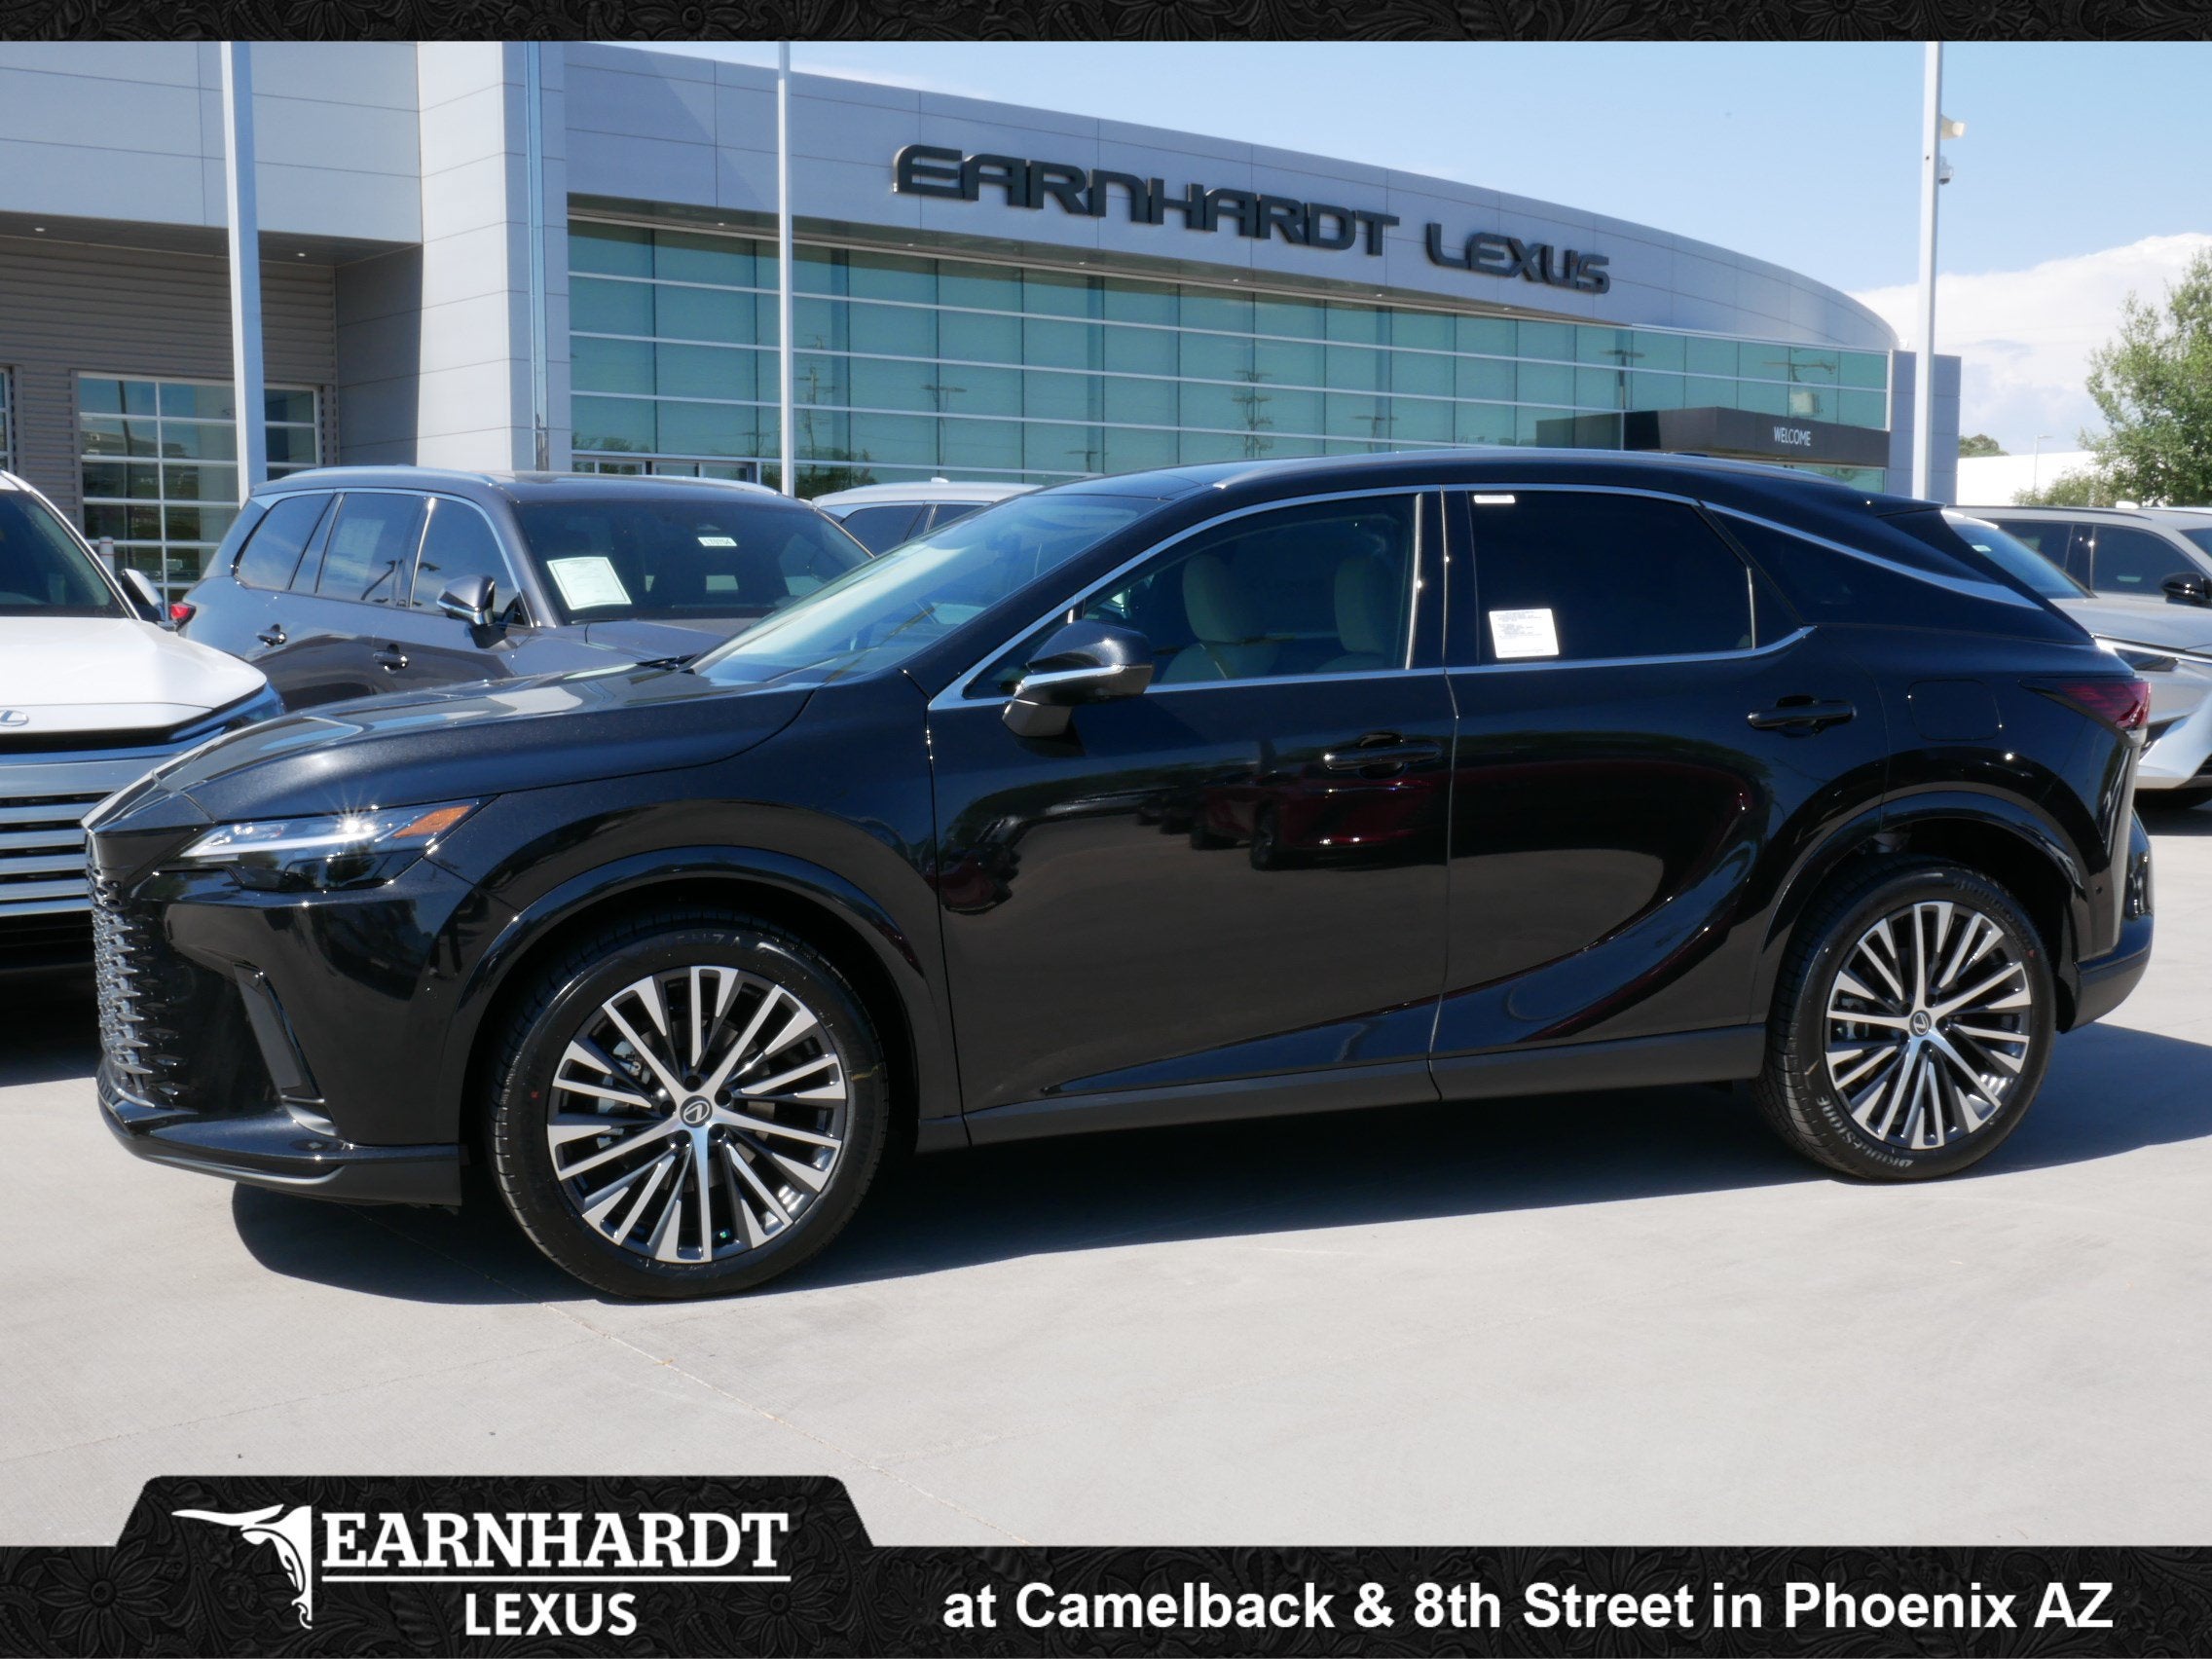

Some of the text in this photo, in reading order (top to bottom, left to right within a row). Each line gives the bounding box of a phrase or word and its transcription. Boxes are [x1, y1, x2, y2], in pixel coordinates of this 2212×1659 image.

[893, 143, 1611, 295] EARNHARDT LEXUS
[1773, 426, 1811, 446] WELCOME
